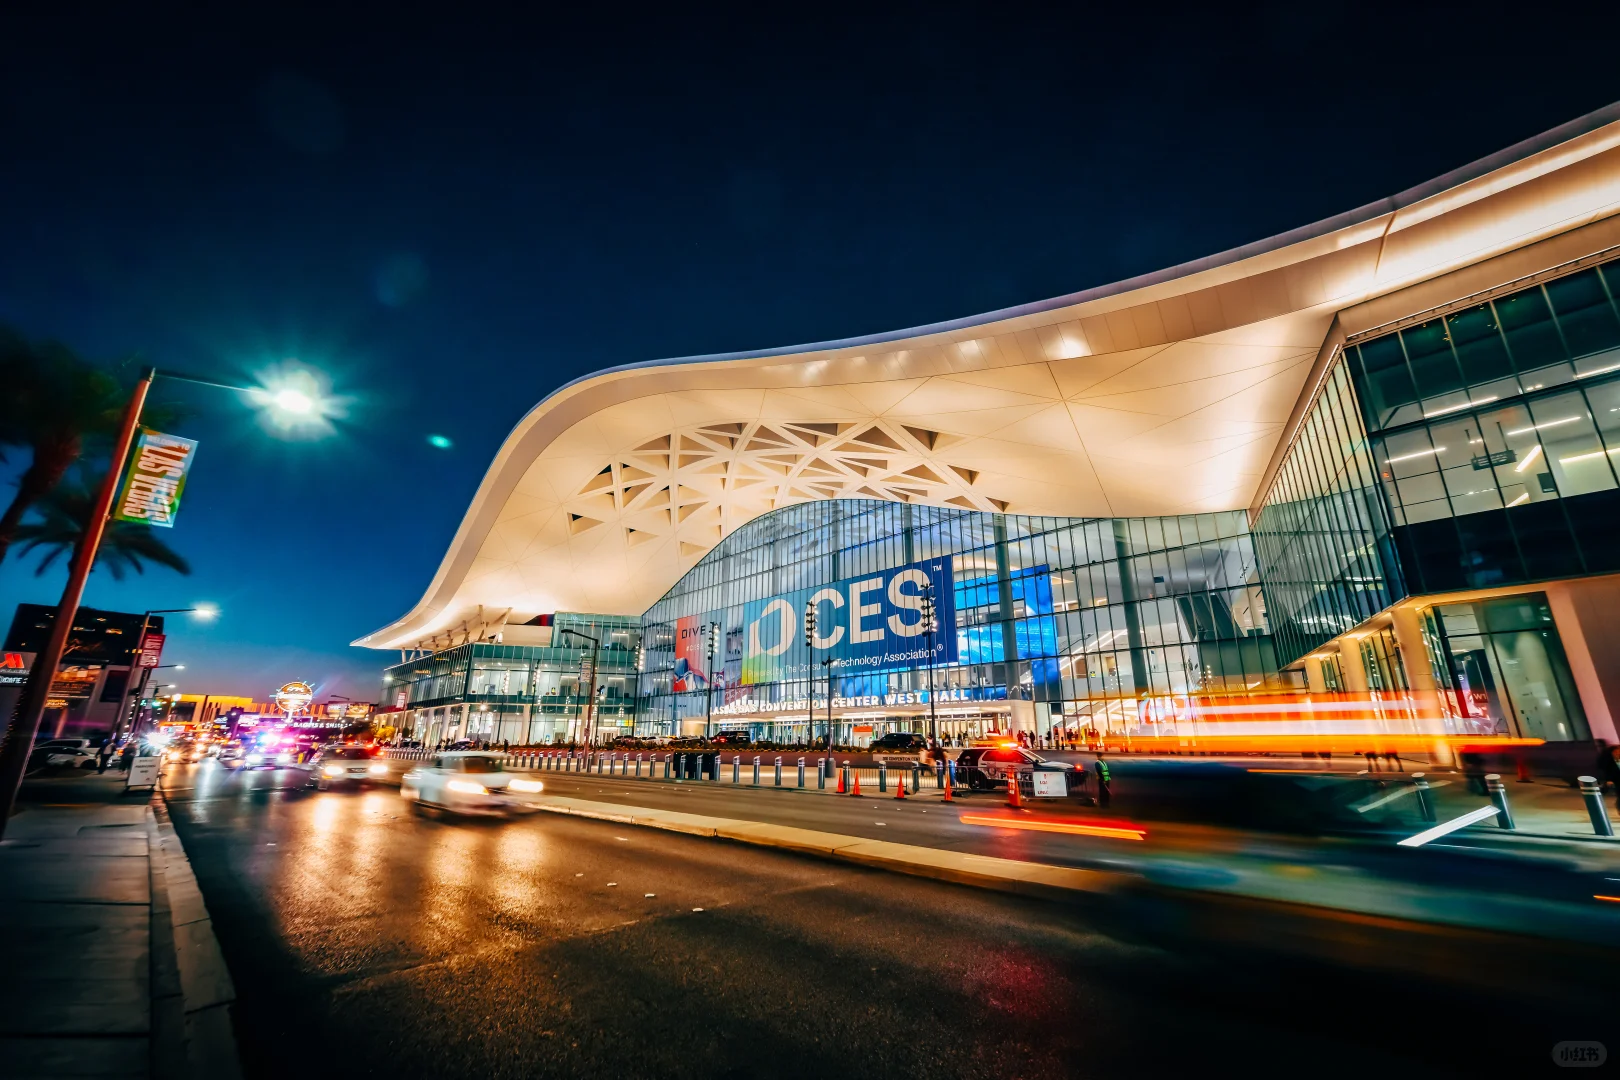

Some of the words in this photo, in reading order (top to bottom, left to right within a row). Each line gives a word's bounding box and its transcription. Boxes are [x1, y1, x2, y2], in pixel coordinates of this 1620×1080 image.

[137, 444, 189, 478] LAS
[122, 473, 180, 522] VEGAS
[804, 568, 933, 650] CES
[681, 625, 706, 639] DIVE
[785, 663, 797, 674] The
[836, 655, 882, 668] Technology
[760, 698, 828, 713] CONVENTION
[831, 694, 880, 708] CENTER
[884, 690, 923, 706] WEST
[929, 688, 969, 702] HALL
